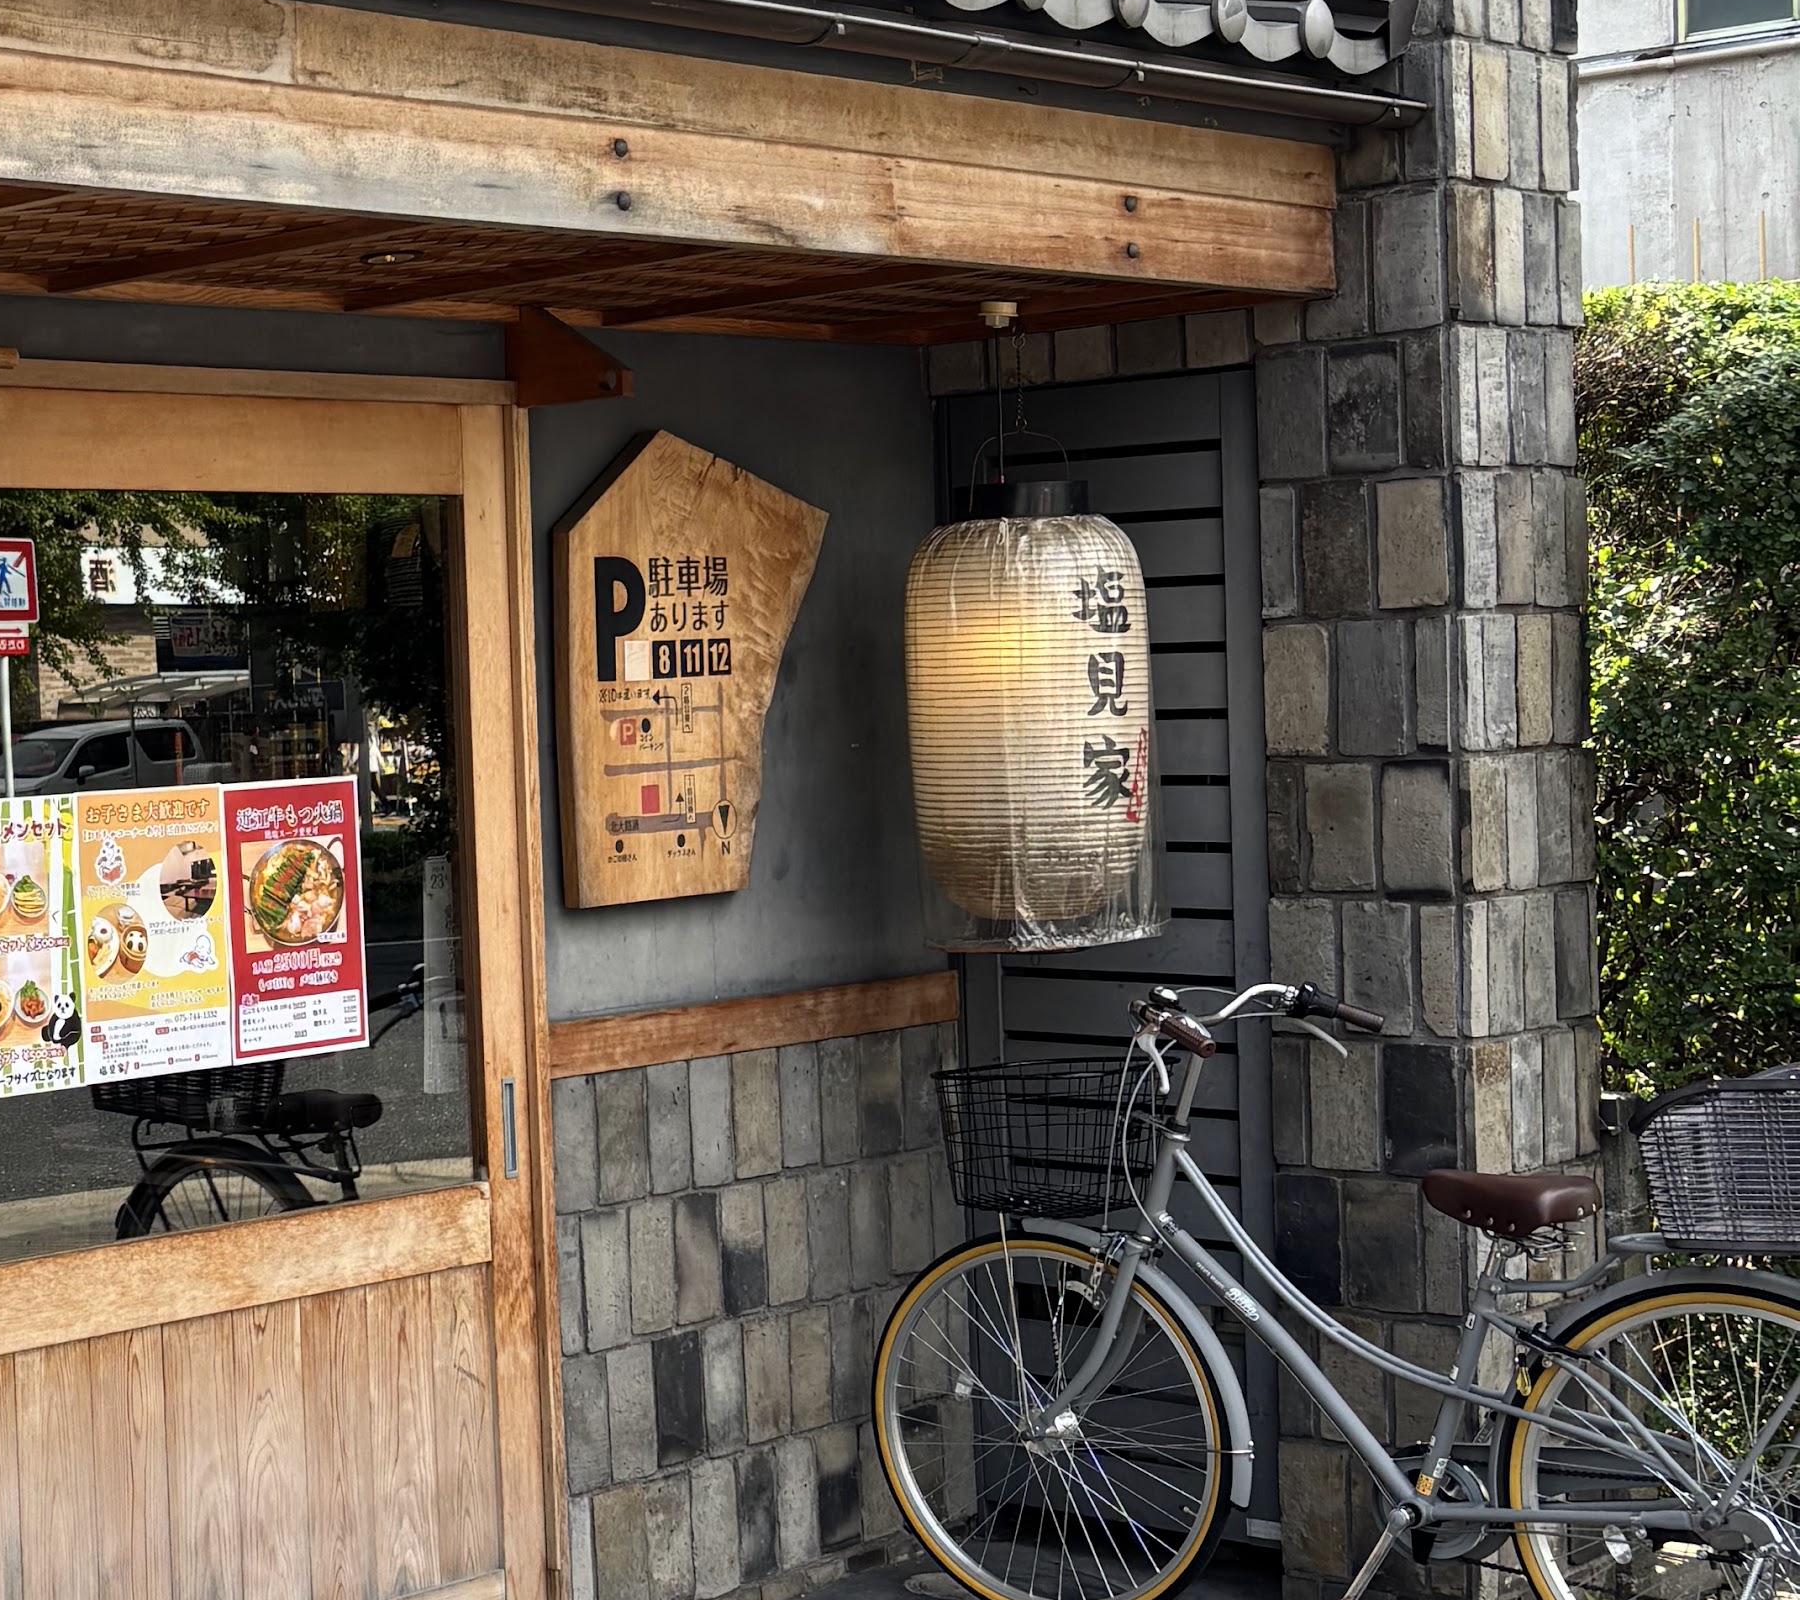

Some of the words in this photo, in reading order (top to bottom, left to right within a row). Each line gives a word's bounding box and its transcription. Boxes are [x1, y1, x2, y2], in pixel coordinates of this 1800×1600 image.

[648, 555, 729, 599] 駐車場
[594, 557, 646, 682] P
[649, 601, 730, 633] あります
[657, 646, 671, 675] 8
[683, 646, 702, 674] 11
[710, 643, 729, 673] 12
[1072, 566, 1131, 811] 塩見家
[86, 798, 211, 825] お子さま大歓迎です
[236, 800, 344, 831] 近江牛もつ火鍋
[721, 840, 731, 856] N
